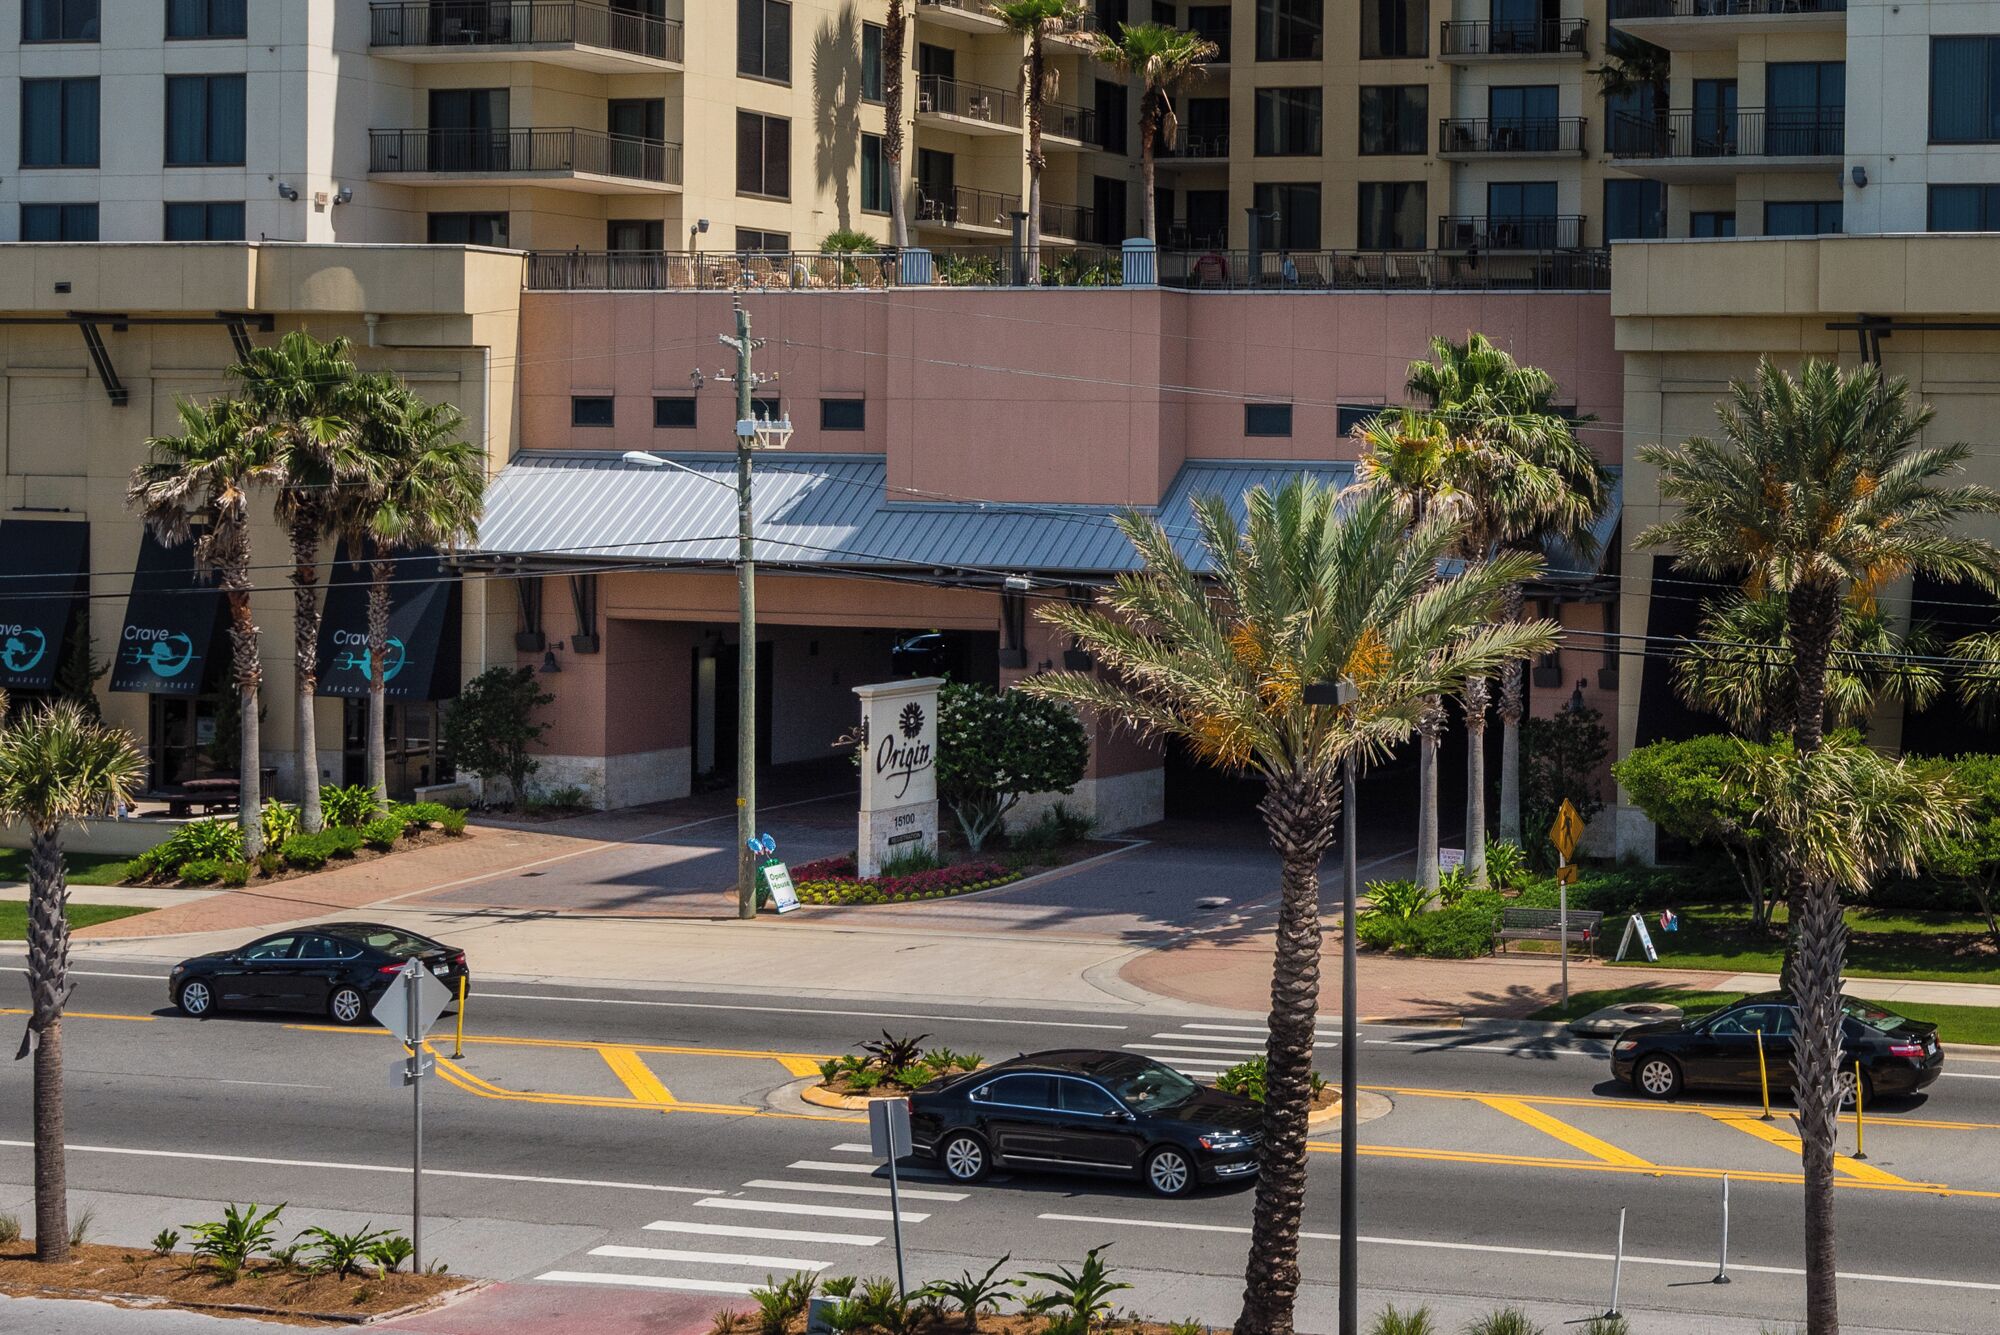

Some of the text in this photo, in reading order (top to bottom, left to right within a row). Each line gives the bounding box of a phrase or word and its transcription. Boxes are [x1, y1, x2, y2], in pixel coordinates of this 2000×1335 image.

[124, 625, 169, 640] Crave
[333, 629, 370, 646] Crav
[115, 680, 195, 689] BEACH MARKET
[327, 685, 360, 693] BEACH
[876, 734, 933, 799] Origin
[894, 812, 916, 827] 15100
[769, 872, 787, 881] Open
[772, 880, 791, 889] House
